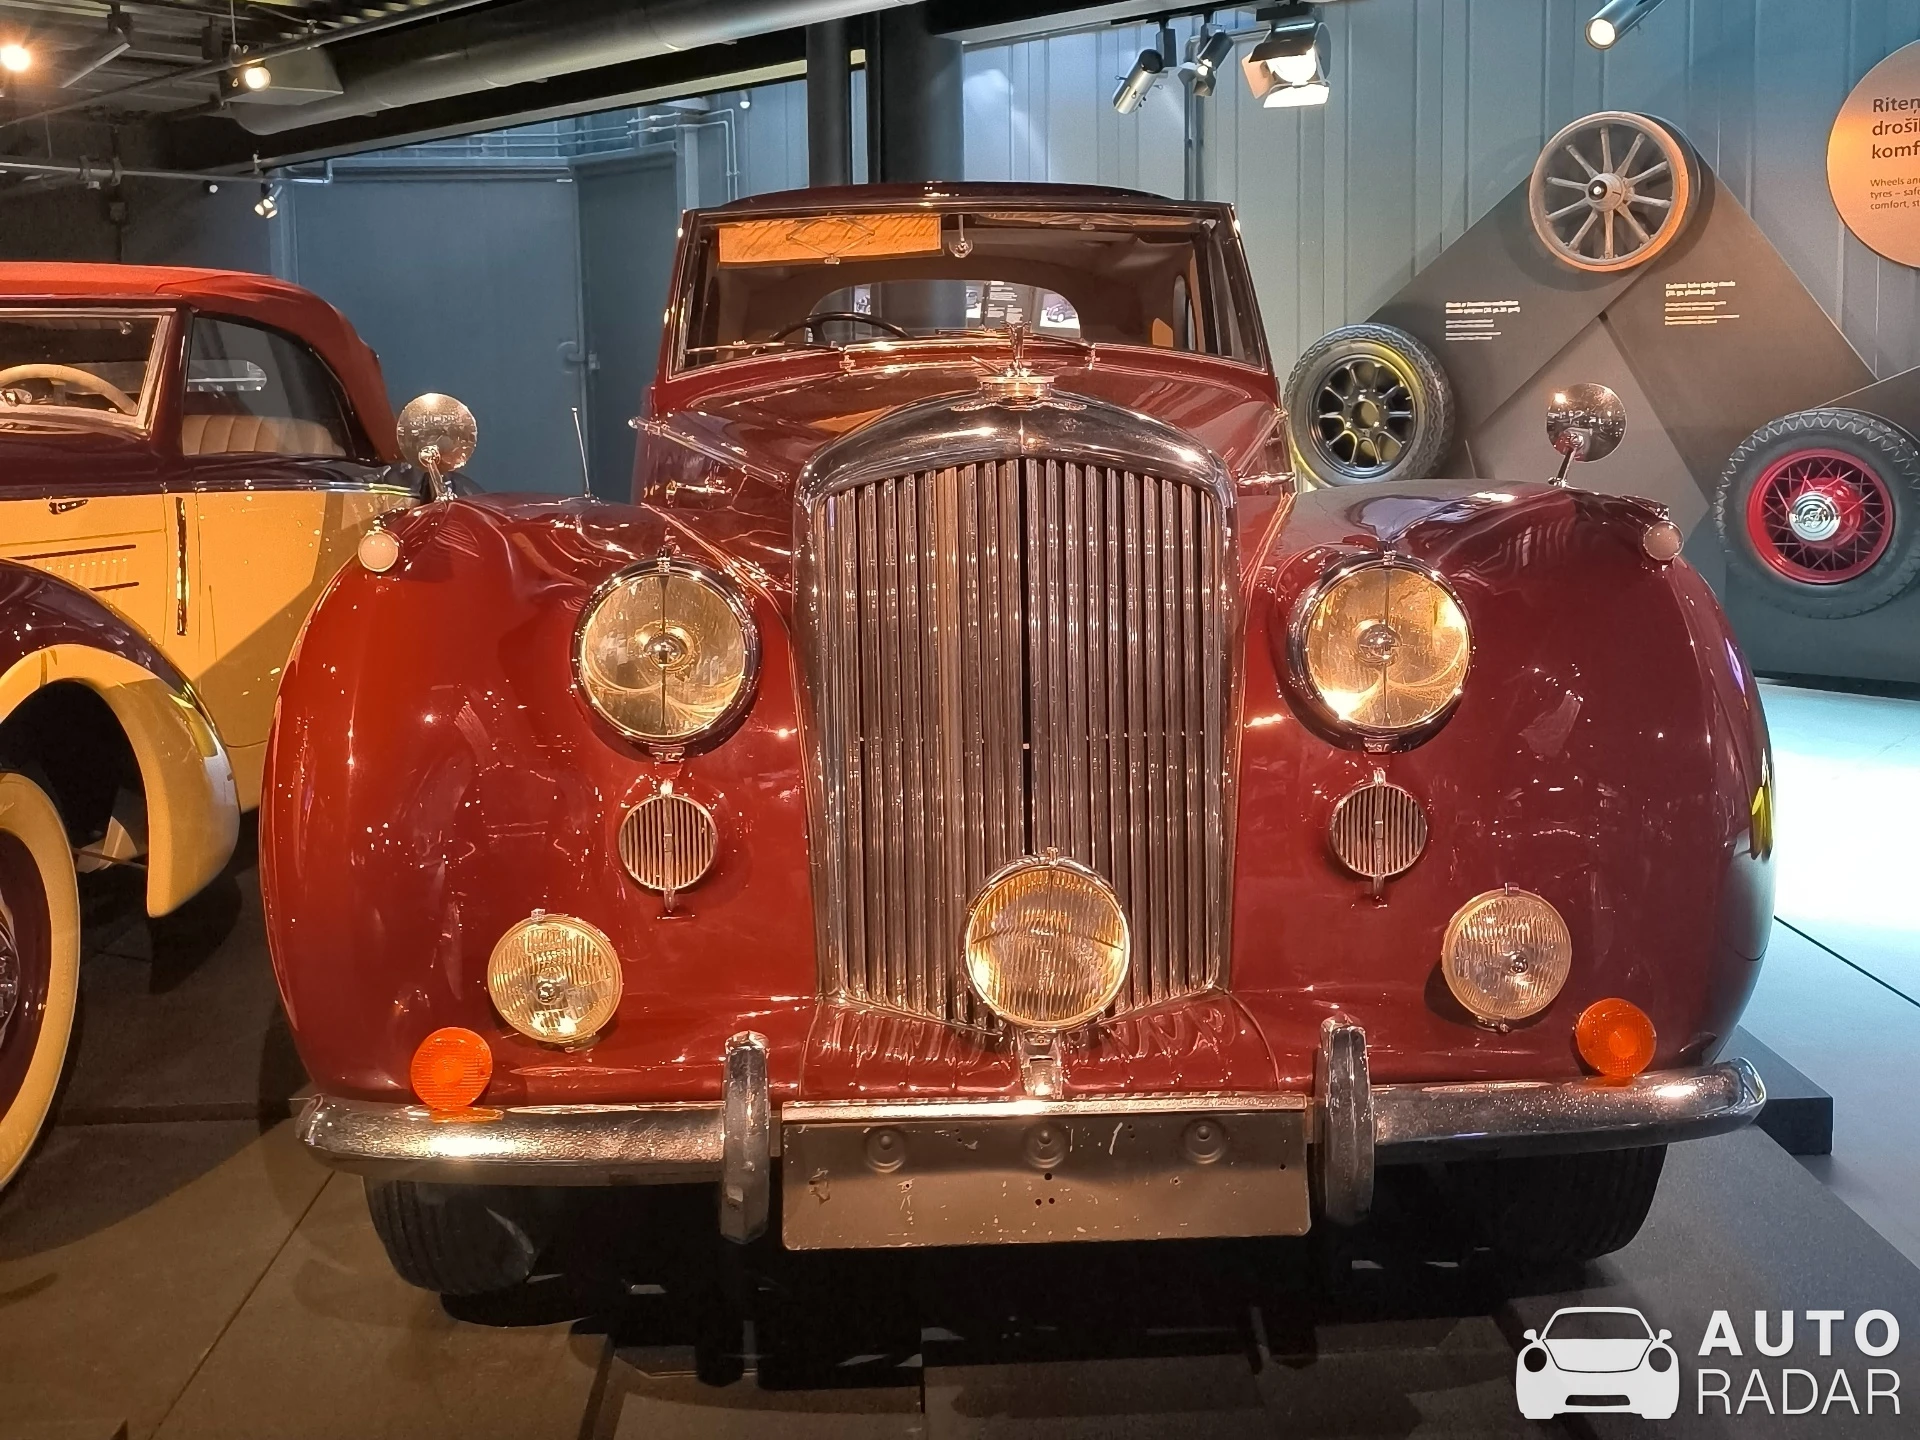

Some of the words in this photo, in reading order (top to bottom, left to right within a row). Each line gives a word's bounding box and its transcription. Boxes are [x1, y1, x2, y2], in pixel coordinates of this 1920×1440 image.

[1872, 118, 1920, 136] drošī
[1870, 177, 1905, 187] Wheels
[1870, 190, 1893, 200] tyres
[1870, 200, 1910, 210] comfort,
